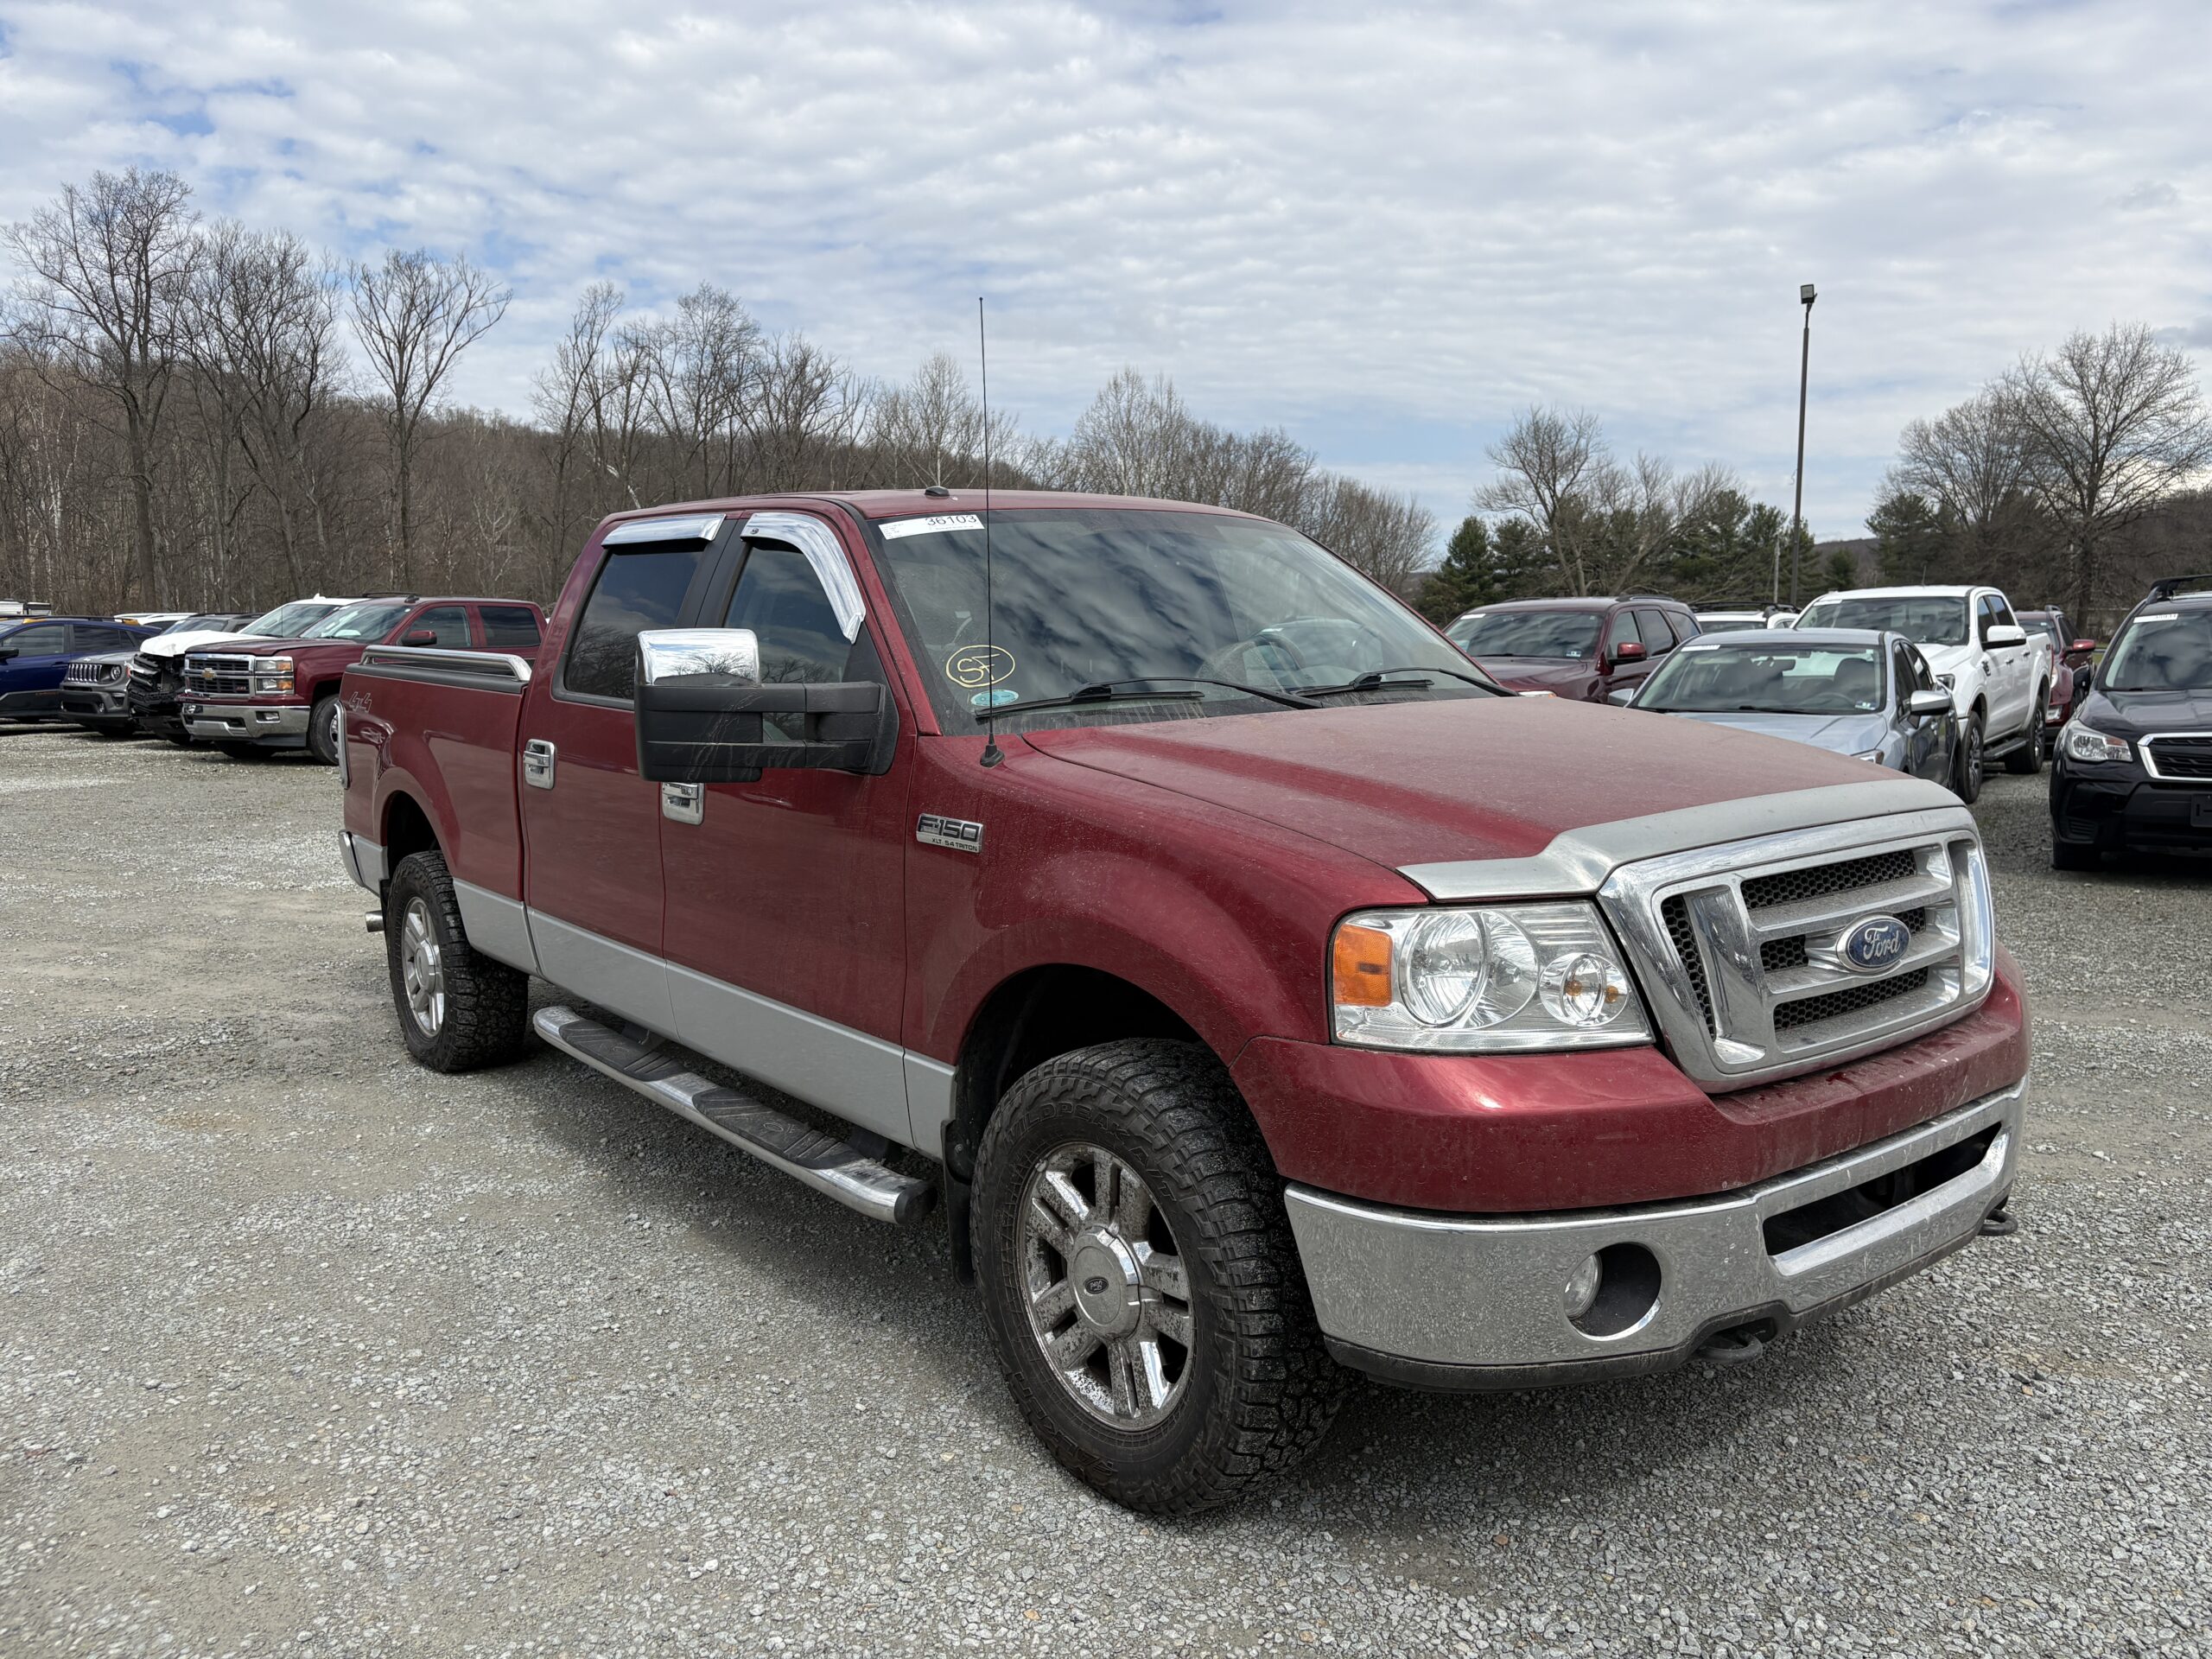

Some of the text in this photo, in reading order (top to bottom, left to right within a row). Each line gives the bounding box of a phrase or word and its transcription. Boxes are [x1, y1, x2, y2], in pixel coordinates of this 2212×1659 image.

[925, 515, 977, 526] 36103
[918, 817, 980, 842] F-150
[956, 842, 978, 852] TRITON
[1863, 925, 1901, 960] Ford
[1005, 1101, 1128, 1144] WILDPEAK
